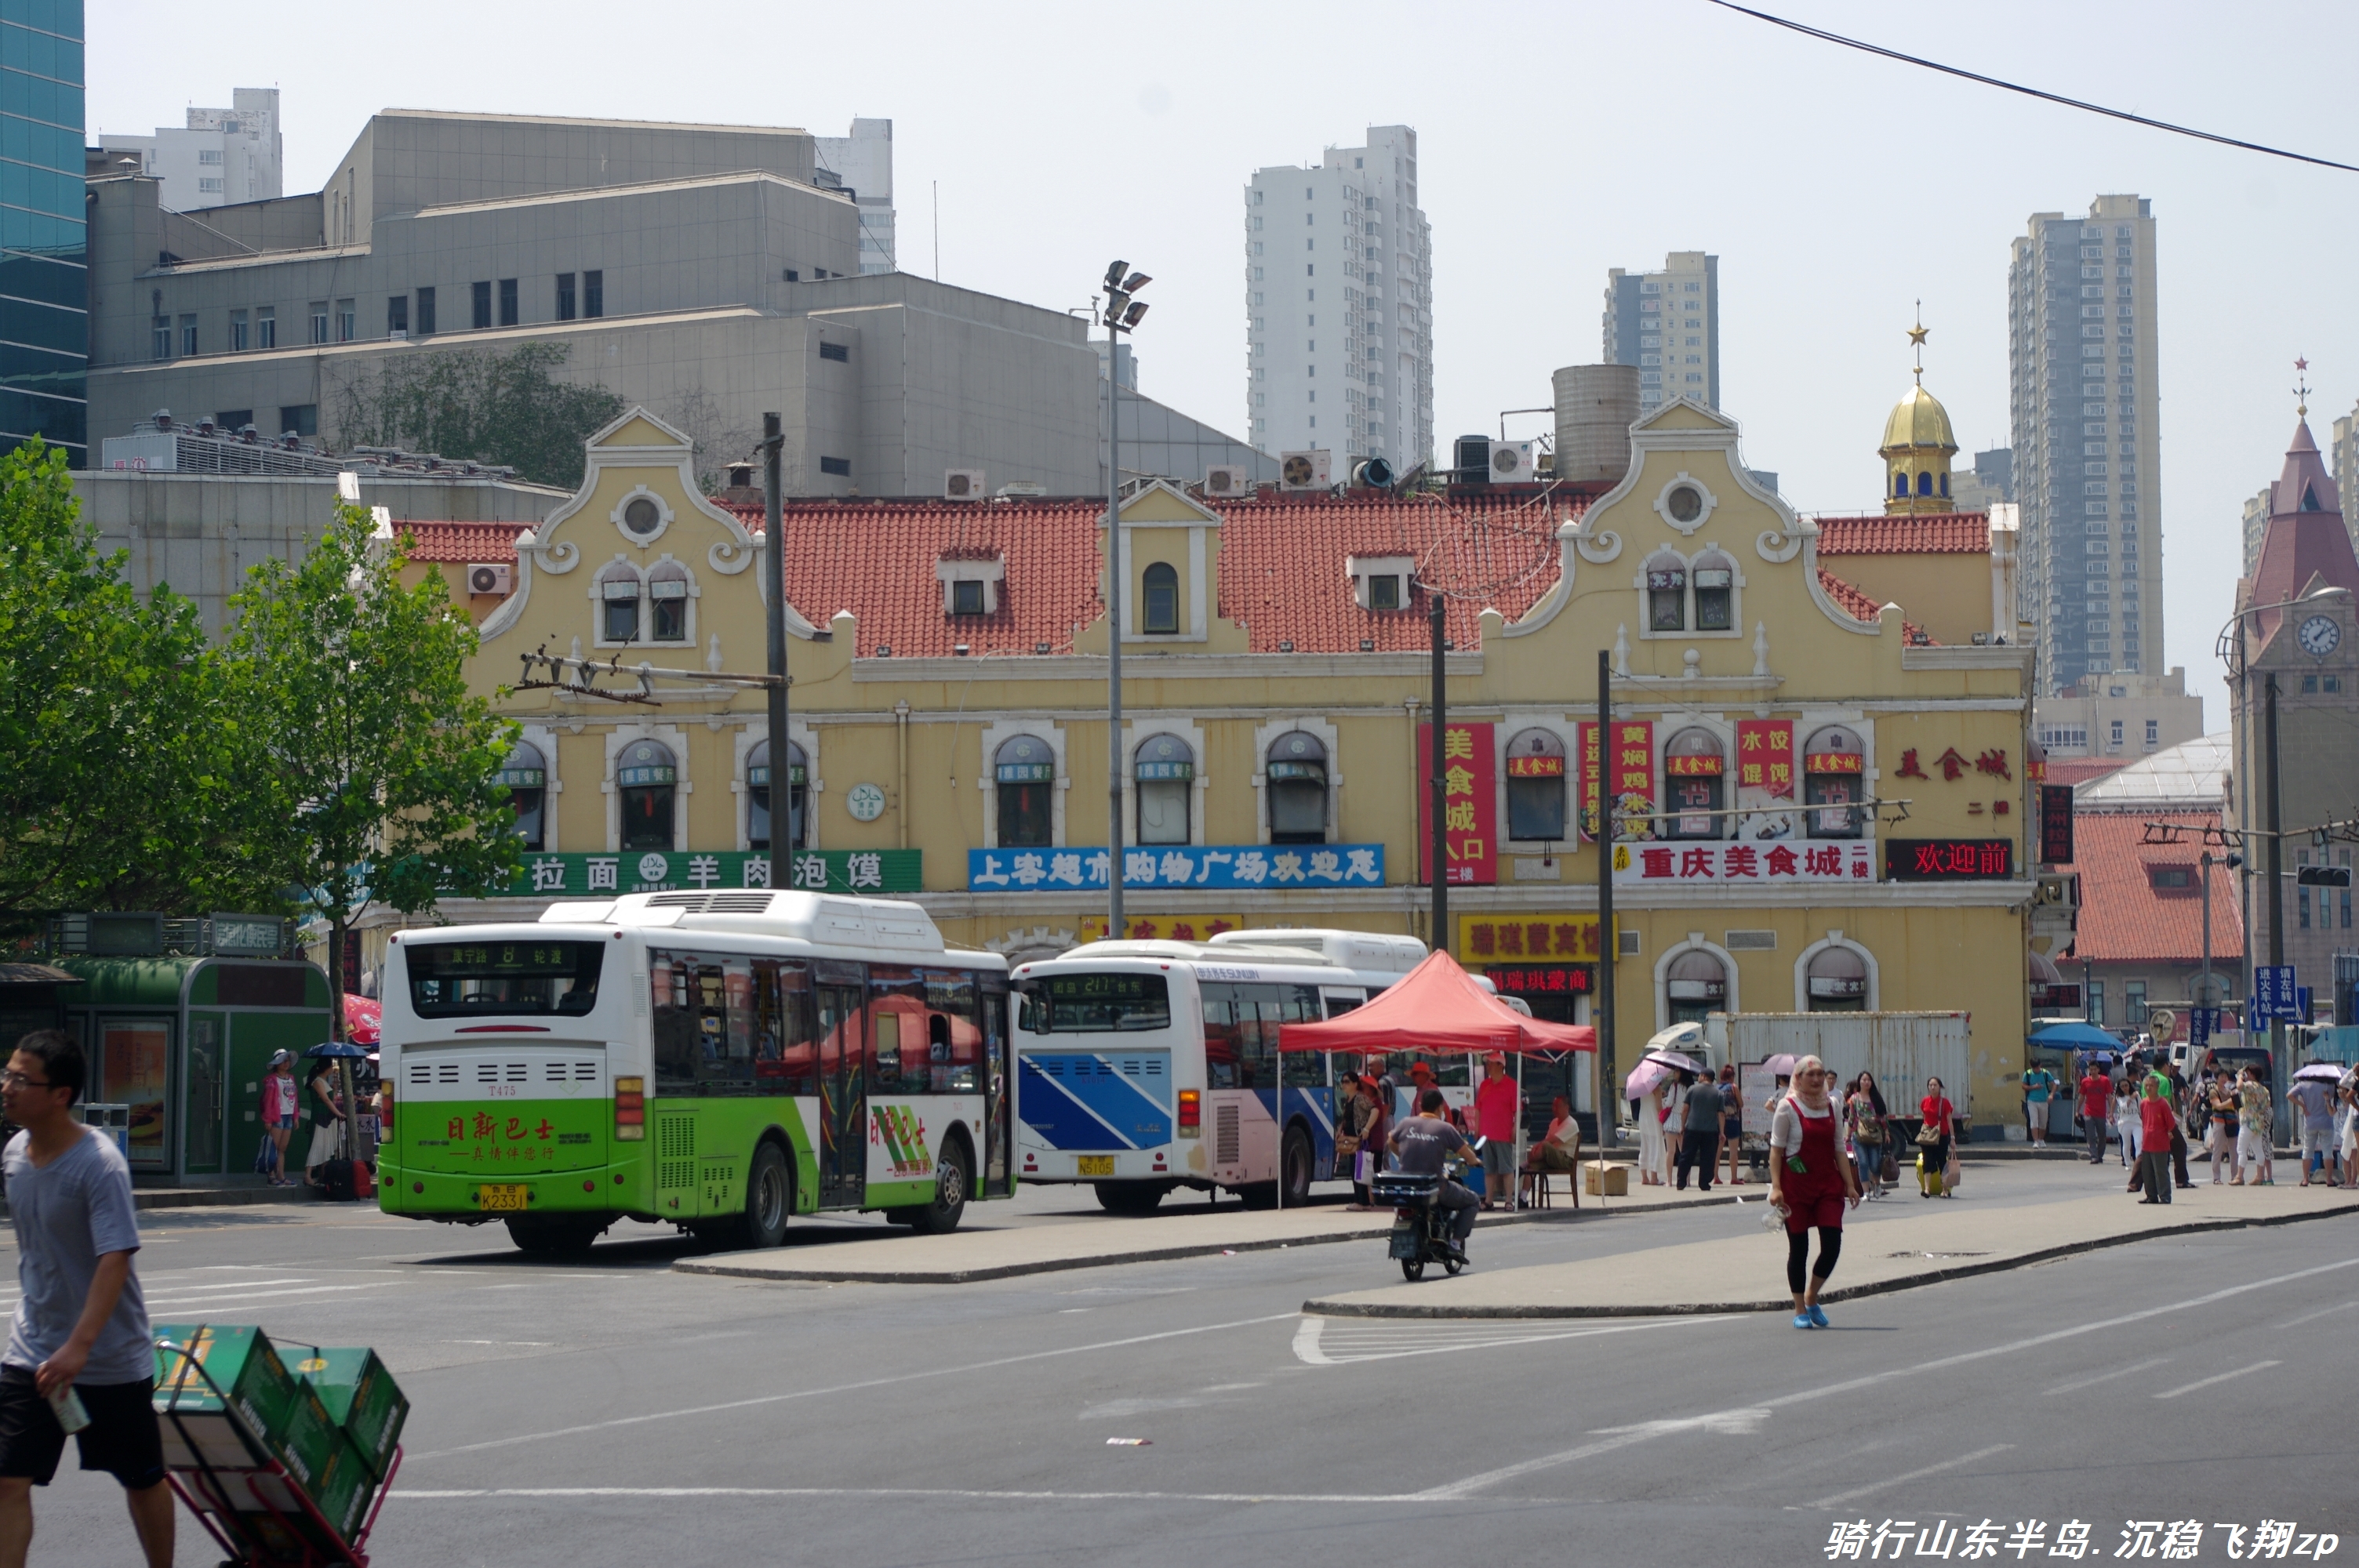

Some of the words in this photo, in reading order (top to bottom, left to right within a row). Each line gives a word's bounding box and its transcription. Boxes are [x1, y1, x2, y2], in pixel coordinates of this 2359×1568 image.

[1743, 731, 1789, 751] 水饺
[1516, 757, 1559, 775] 美食城
[1674, 757, 1717, 775] 美食城
[1743, 764, 1789, 785] 馄饨
[1814, 753, 1857, 771] 美食城
[1895, 747, 2012, 781] 美食城
[1445, 728, 1476, 832] 美食城
[1621, 726, 1648, 835] 黄焖鸡米饭
[687, 853, 882, 889] 羊肉泡馍
[1639, 844, 1843, 879] 重庆美食城
[1852, 845, 1869, 879] 二楼
[1914, 842, 2008, 875] 欢迎前
[2259, 967, 2273, 1014] 进火车站
[2279, 967, 2292, 1003] 请左转
[489, 1086, 516, 1097] T475
[448, 1111, 554, 1144] 日新巴士
[870, 1105, 926, 1151] 日新巴士
[1080, 1163, 1112, 1174] N5105
[482, 1194, 524, 1209] K2331
